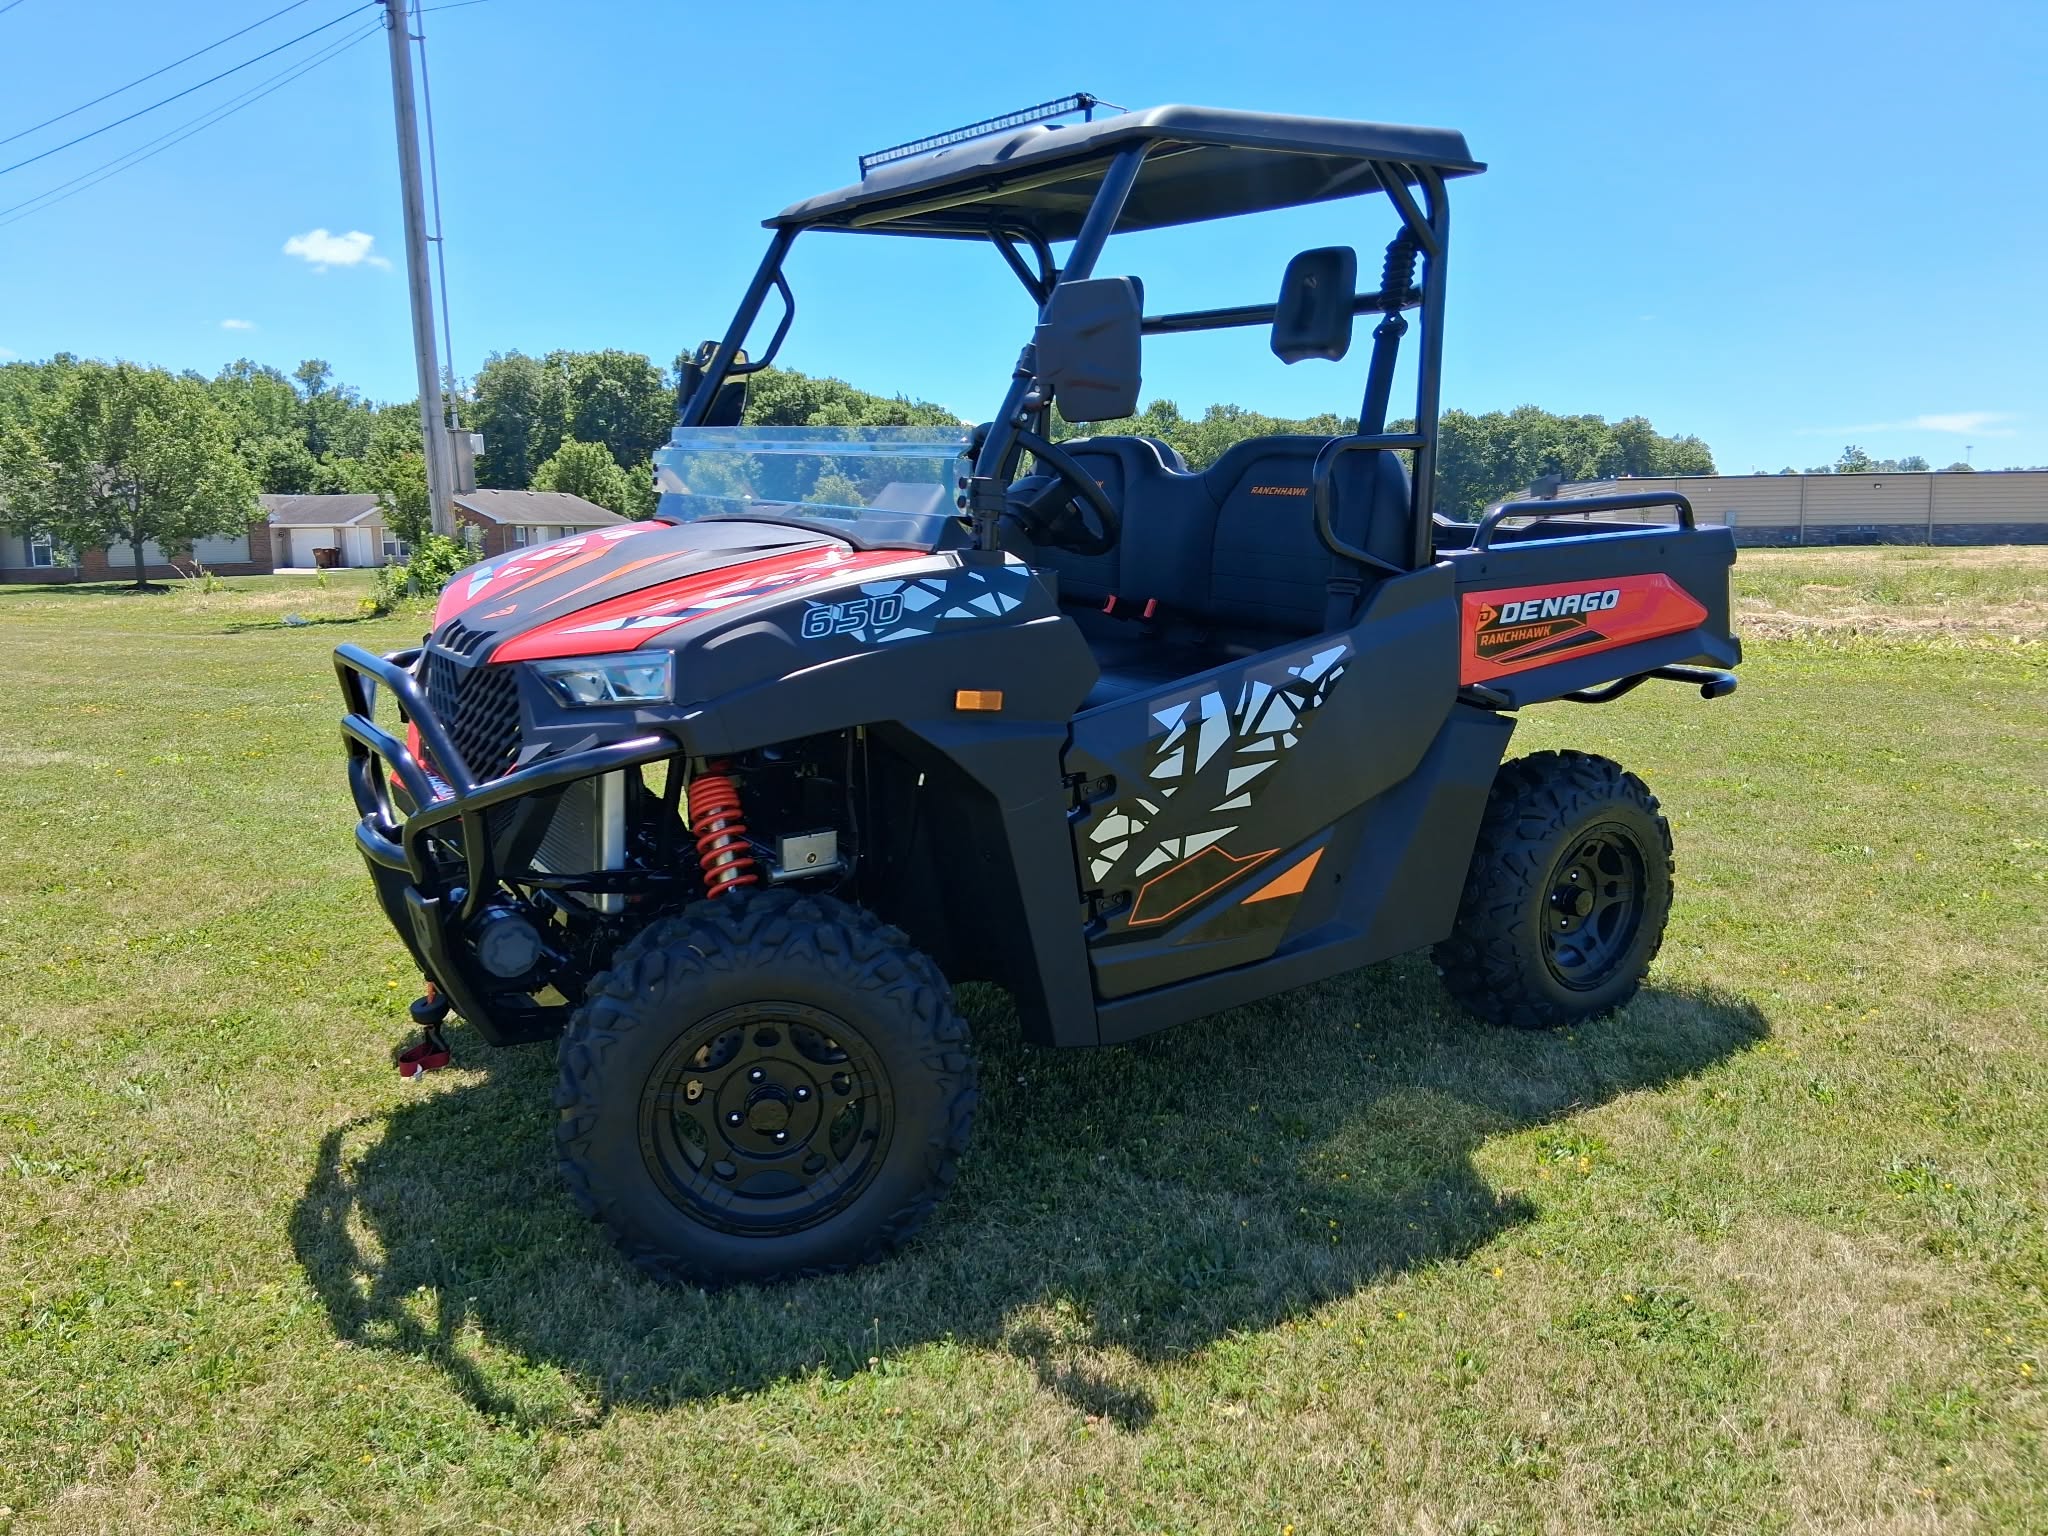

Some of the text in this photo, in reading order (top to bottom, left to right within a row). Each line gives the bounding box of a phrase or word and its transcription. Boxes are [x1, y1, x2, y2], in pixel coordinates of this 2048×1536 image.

[1250, 486, 1309, 496] RANCHHAWK
[801, 593, 905, 639] 650
[1499, 589, 1621, 624] DENAGO
[1480, 625, 1552, 646] RANCHHAWK
